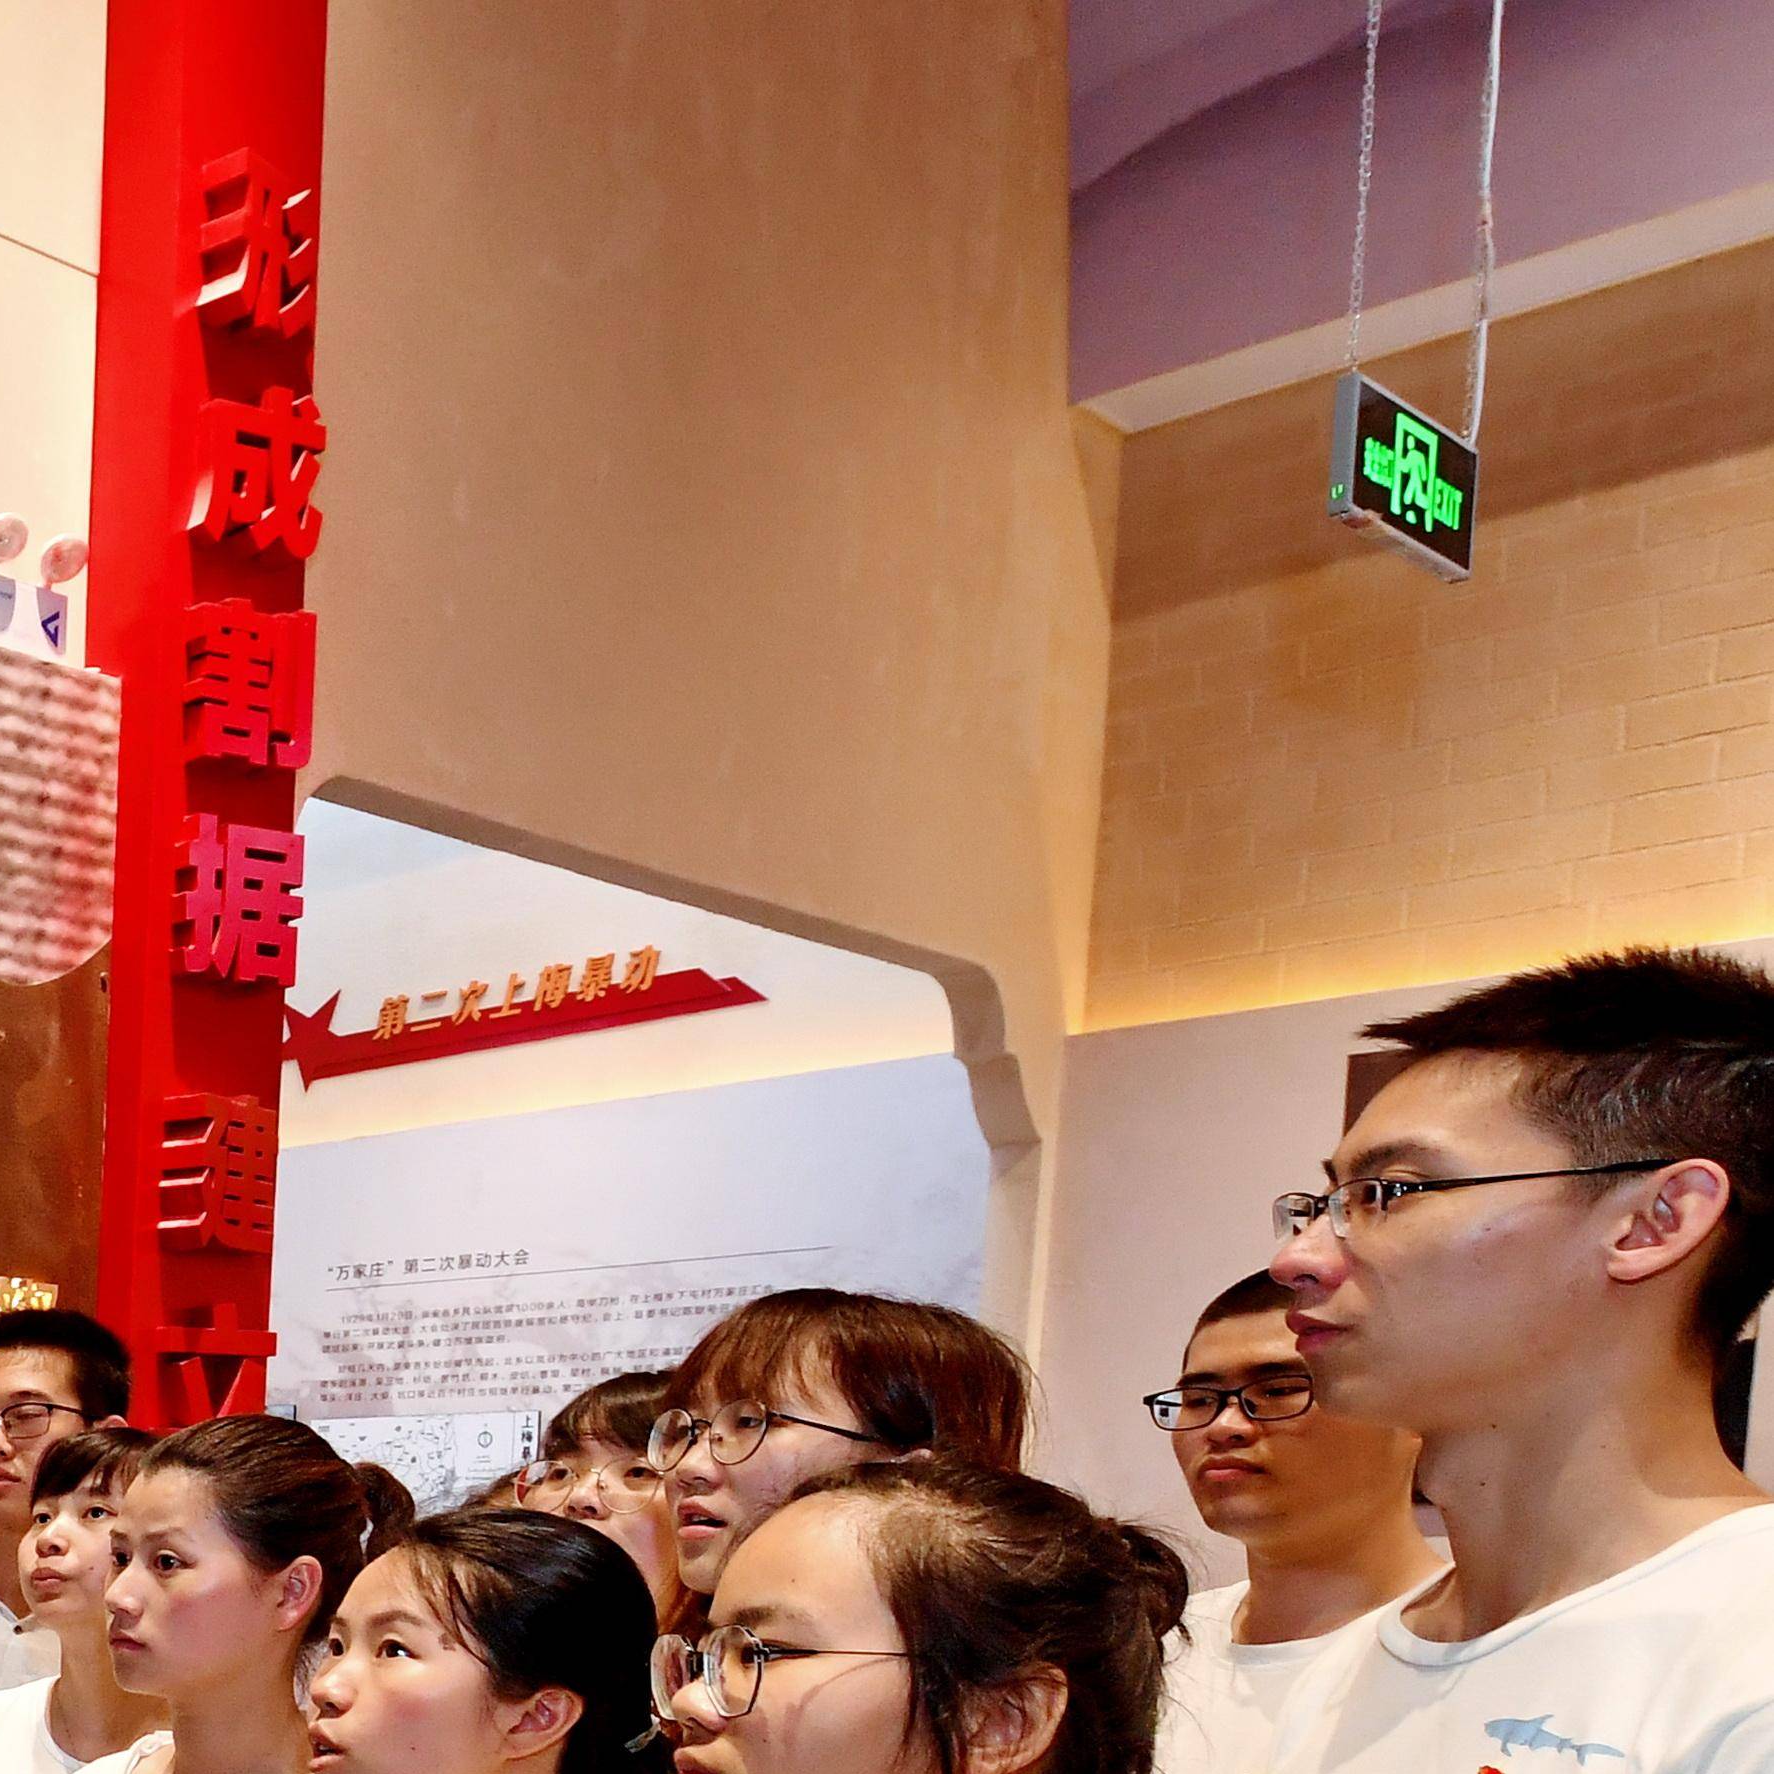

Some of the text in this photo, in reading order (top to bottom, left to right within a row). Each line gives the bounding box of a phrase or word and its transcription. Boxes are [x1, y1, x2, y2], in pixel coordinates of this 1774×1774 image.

[1433, 477, 1463, 530] EXIT
[169, 147, 326, 988] 形成割据
[371, 944, 662, 1041] 第二次上梅暴动
